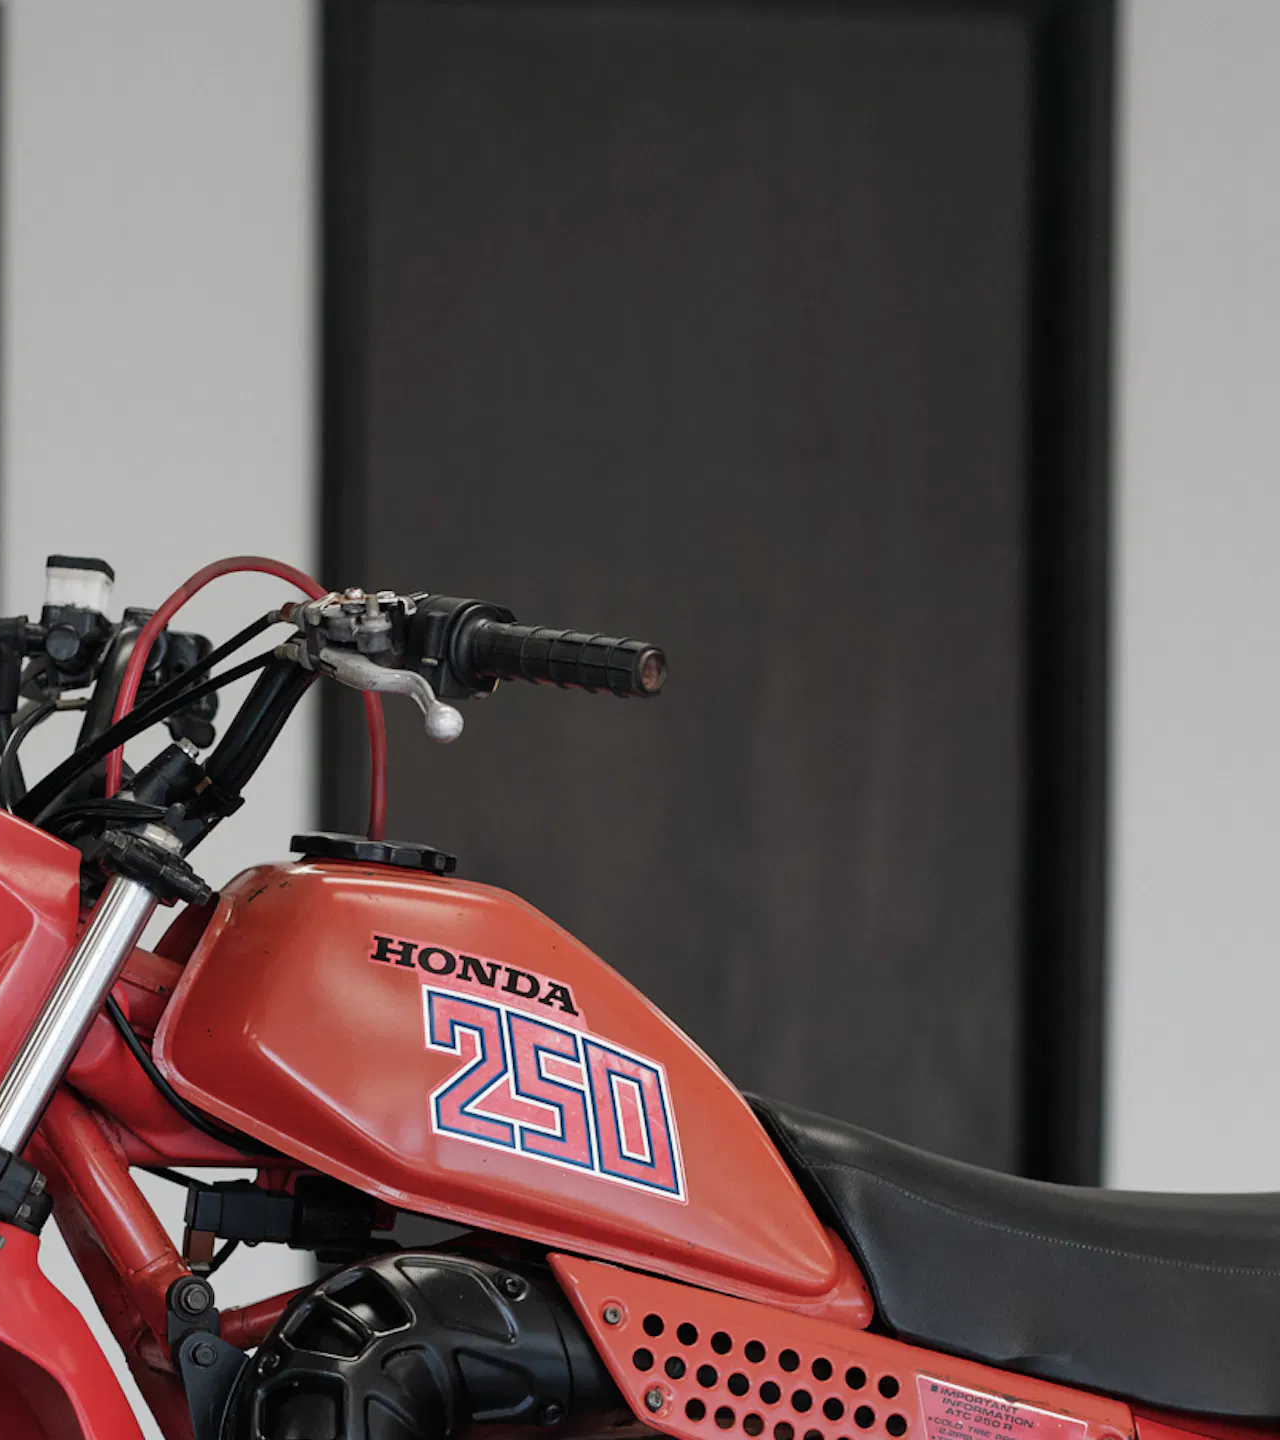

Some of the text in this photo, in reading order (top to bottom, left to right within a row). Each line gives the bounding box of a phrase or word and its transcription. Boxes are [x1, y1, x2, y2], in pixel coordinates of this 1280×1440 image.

[370, 935, 579, 1017] HONDA
[422, 984, 687, 1203] 250
[941, 1388, 1019, 1414] IMPORTANT
[942, 1397, 1034, 1429] INFORMATION
[934, 1417, 963, 1430] COLD
[968, 1426, 991, 1438] TIRE
[945, 1408, 1013, 1432] ATC 250 R
